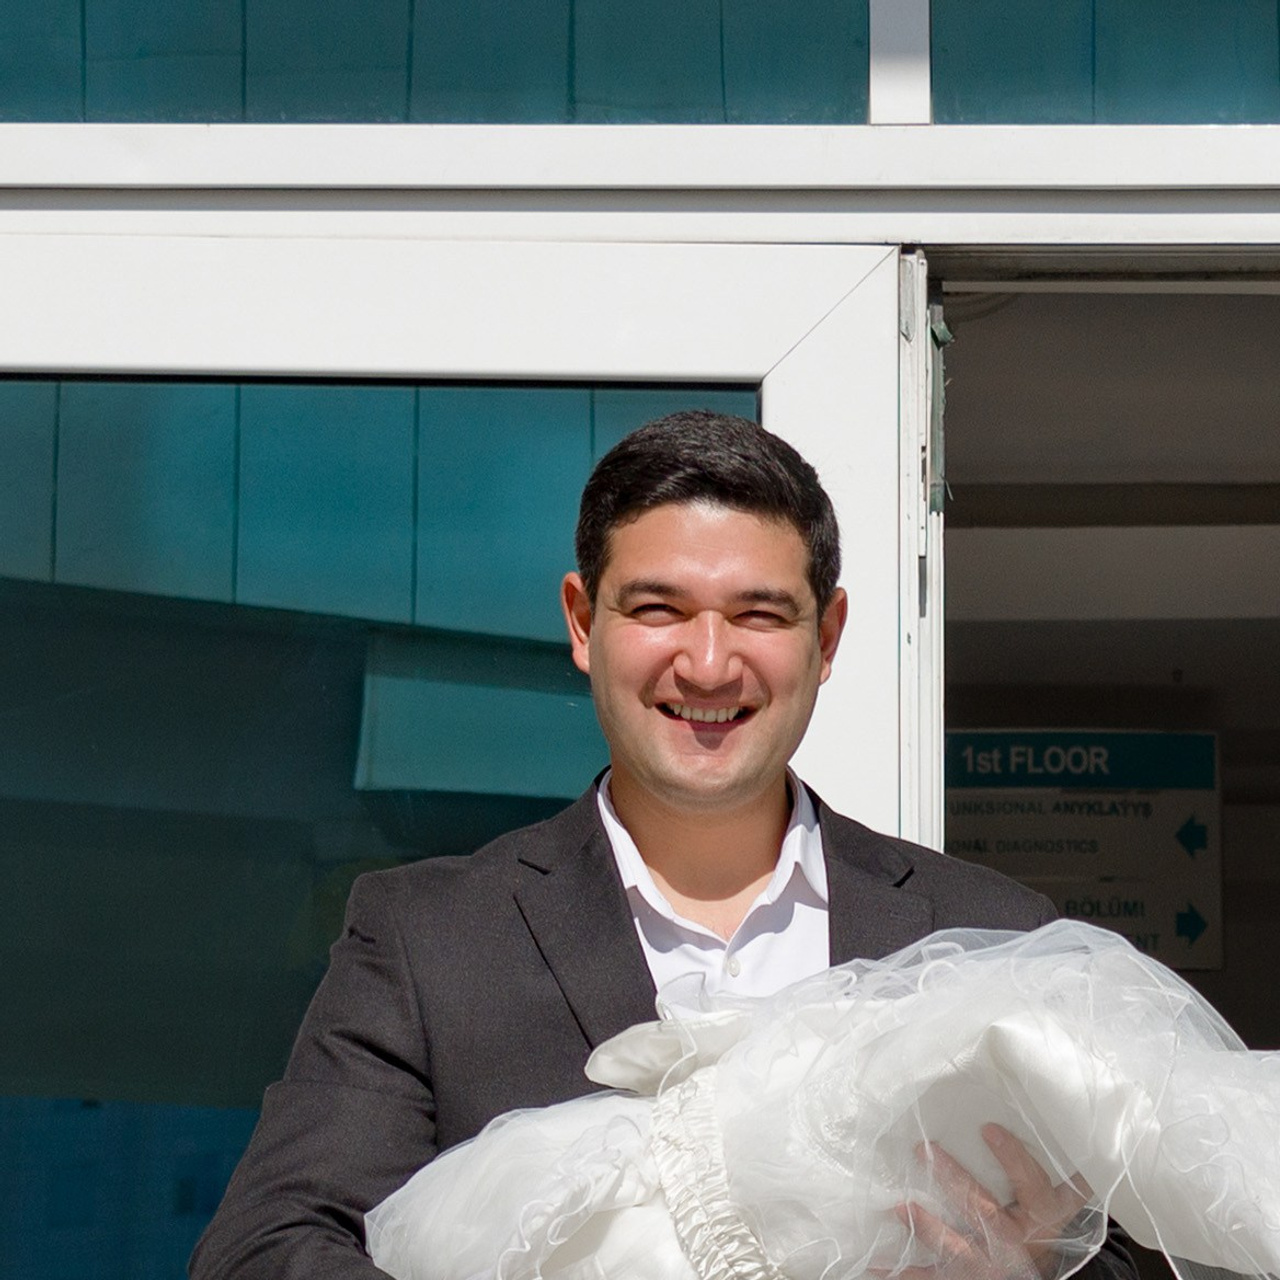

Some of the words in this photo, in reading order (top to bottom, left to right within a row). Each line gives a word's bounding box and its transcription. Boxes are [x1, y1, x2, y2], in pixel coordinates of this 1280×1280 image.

[962, 745, 1002, 774] 1st
[1010, 745, 1110, 774] FLOOR
[995, 839, 1099, 854] DIAGNOSTICS
